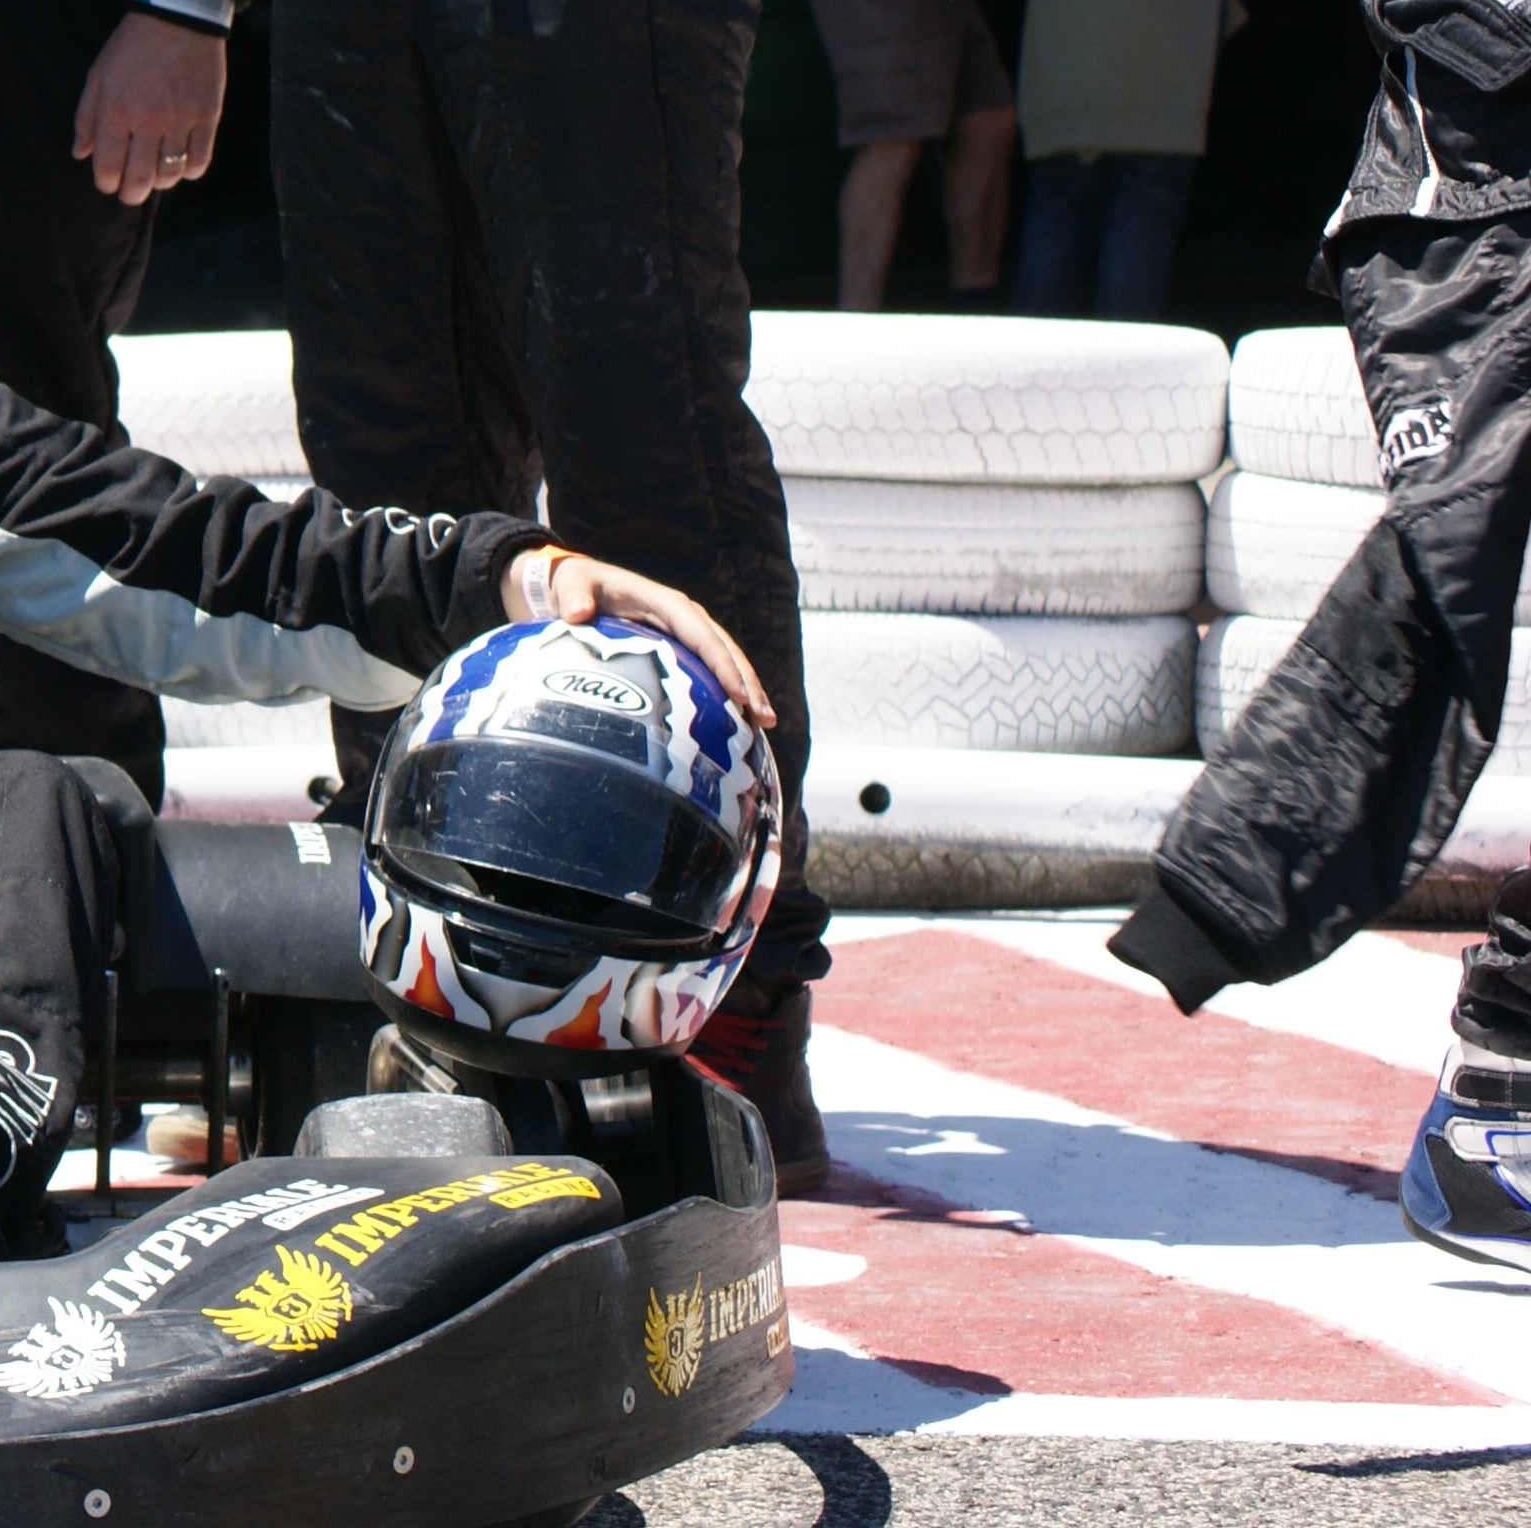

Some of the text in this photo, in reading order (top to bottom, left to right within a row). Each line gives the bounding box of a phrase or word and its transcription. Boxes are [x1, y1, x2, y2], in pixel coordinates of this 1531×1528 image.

[315, 1162, 572, 1267] IMPERIALE
[501, 1179, 595, 1204] RACING
[87, 1178, 349, 1316] IMPERIALE
[709, 1255, 782, 1343] IMPERIA
